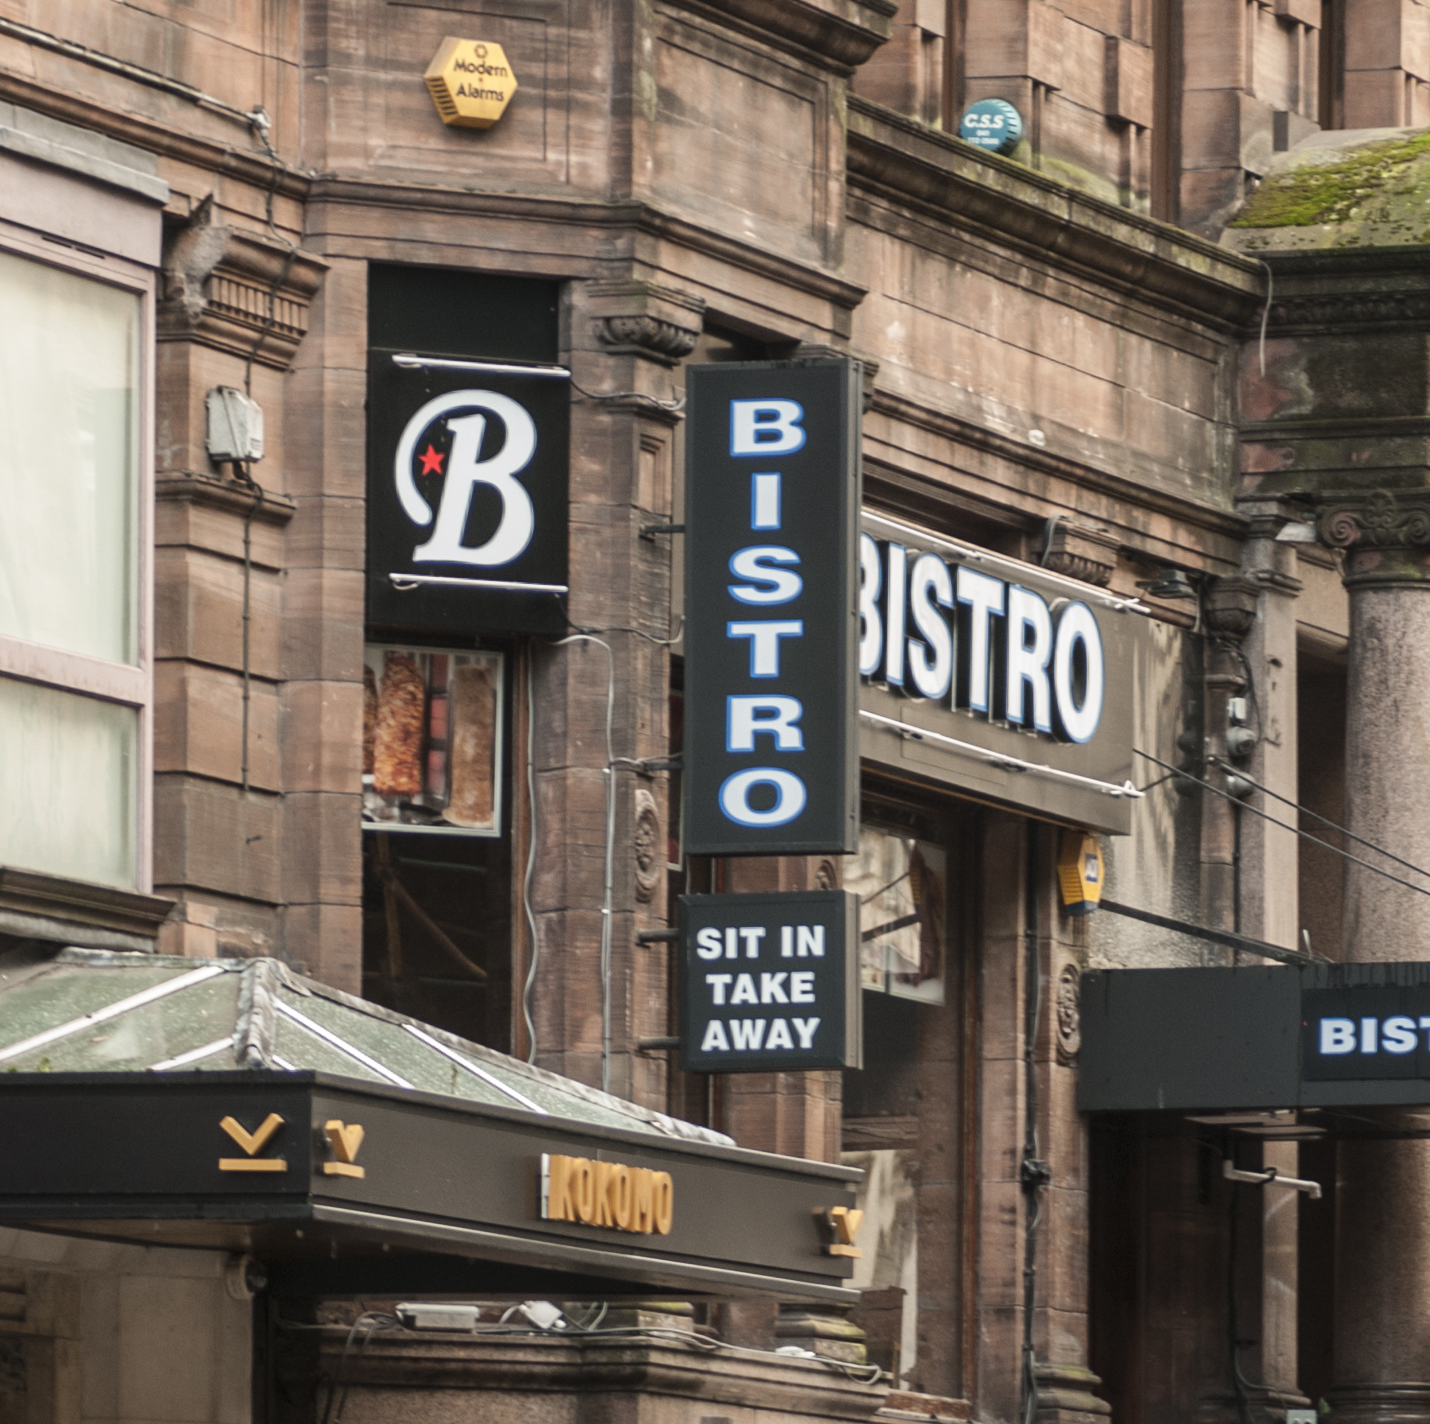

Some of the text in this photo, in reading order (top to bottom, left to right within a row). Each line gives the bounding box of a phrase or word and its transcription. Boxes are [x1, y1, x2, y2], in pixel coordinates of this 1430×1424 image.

[453, 57, 508, 78] Modern
[456, 83, 505, 102] Alarms
[718, 398, 807, 828] BISTRO
[859, 531, 1105, 744] BISTRO
[696, 925, 826, 960] SIT IN
[705, 971, 816, 1005] TAKE
[701, 1017, 821, 1051] AWAY
[541, 1153, 673, 1235] KOKOMO
